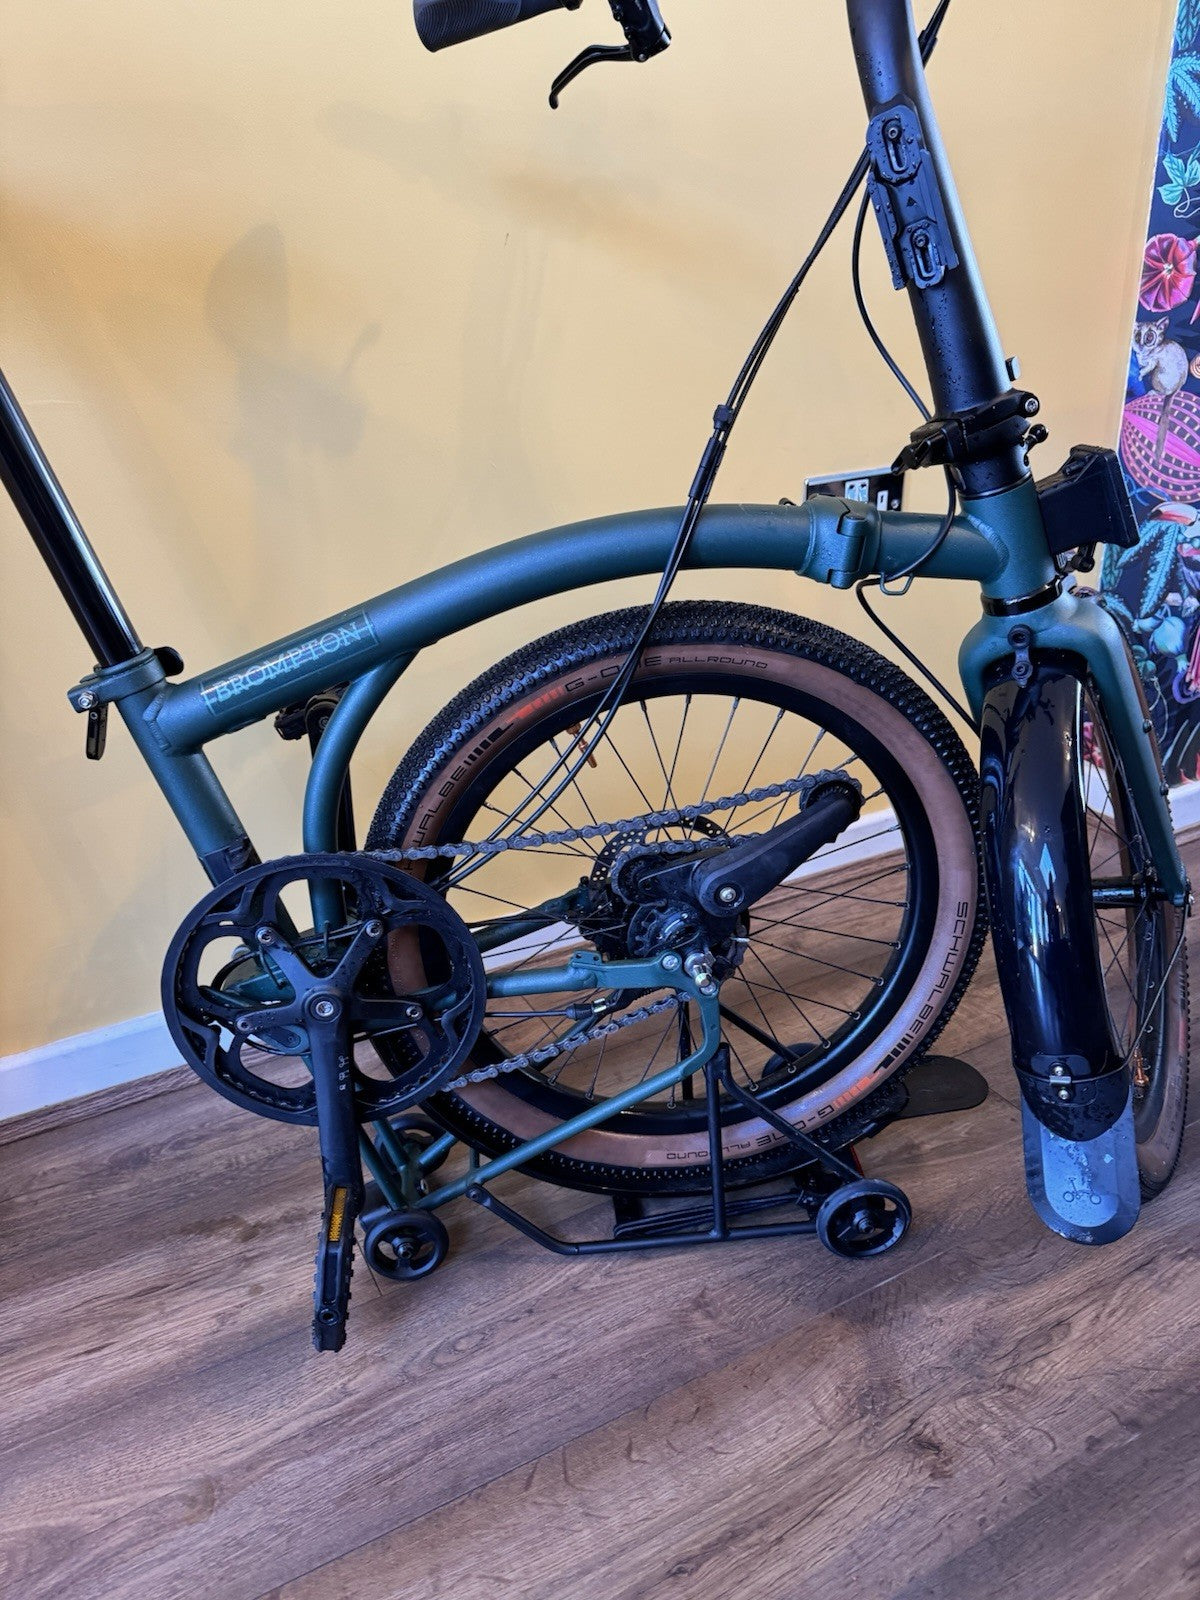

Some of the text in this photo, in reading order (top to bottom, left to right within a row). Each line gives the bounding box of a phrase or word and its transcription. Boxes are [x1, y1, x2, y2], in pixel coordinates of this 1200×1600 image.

[213, 620, 364, 702] BROMPTON
[564, 655, 769, 692] G-OE ALLROUND
[908, 901, 969, 1035] SCHWALBE
[666, 1141, 751, 1160] ALLOUND
